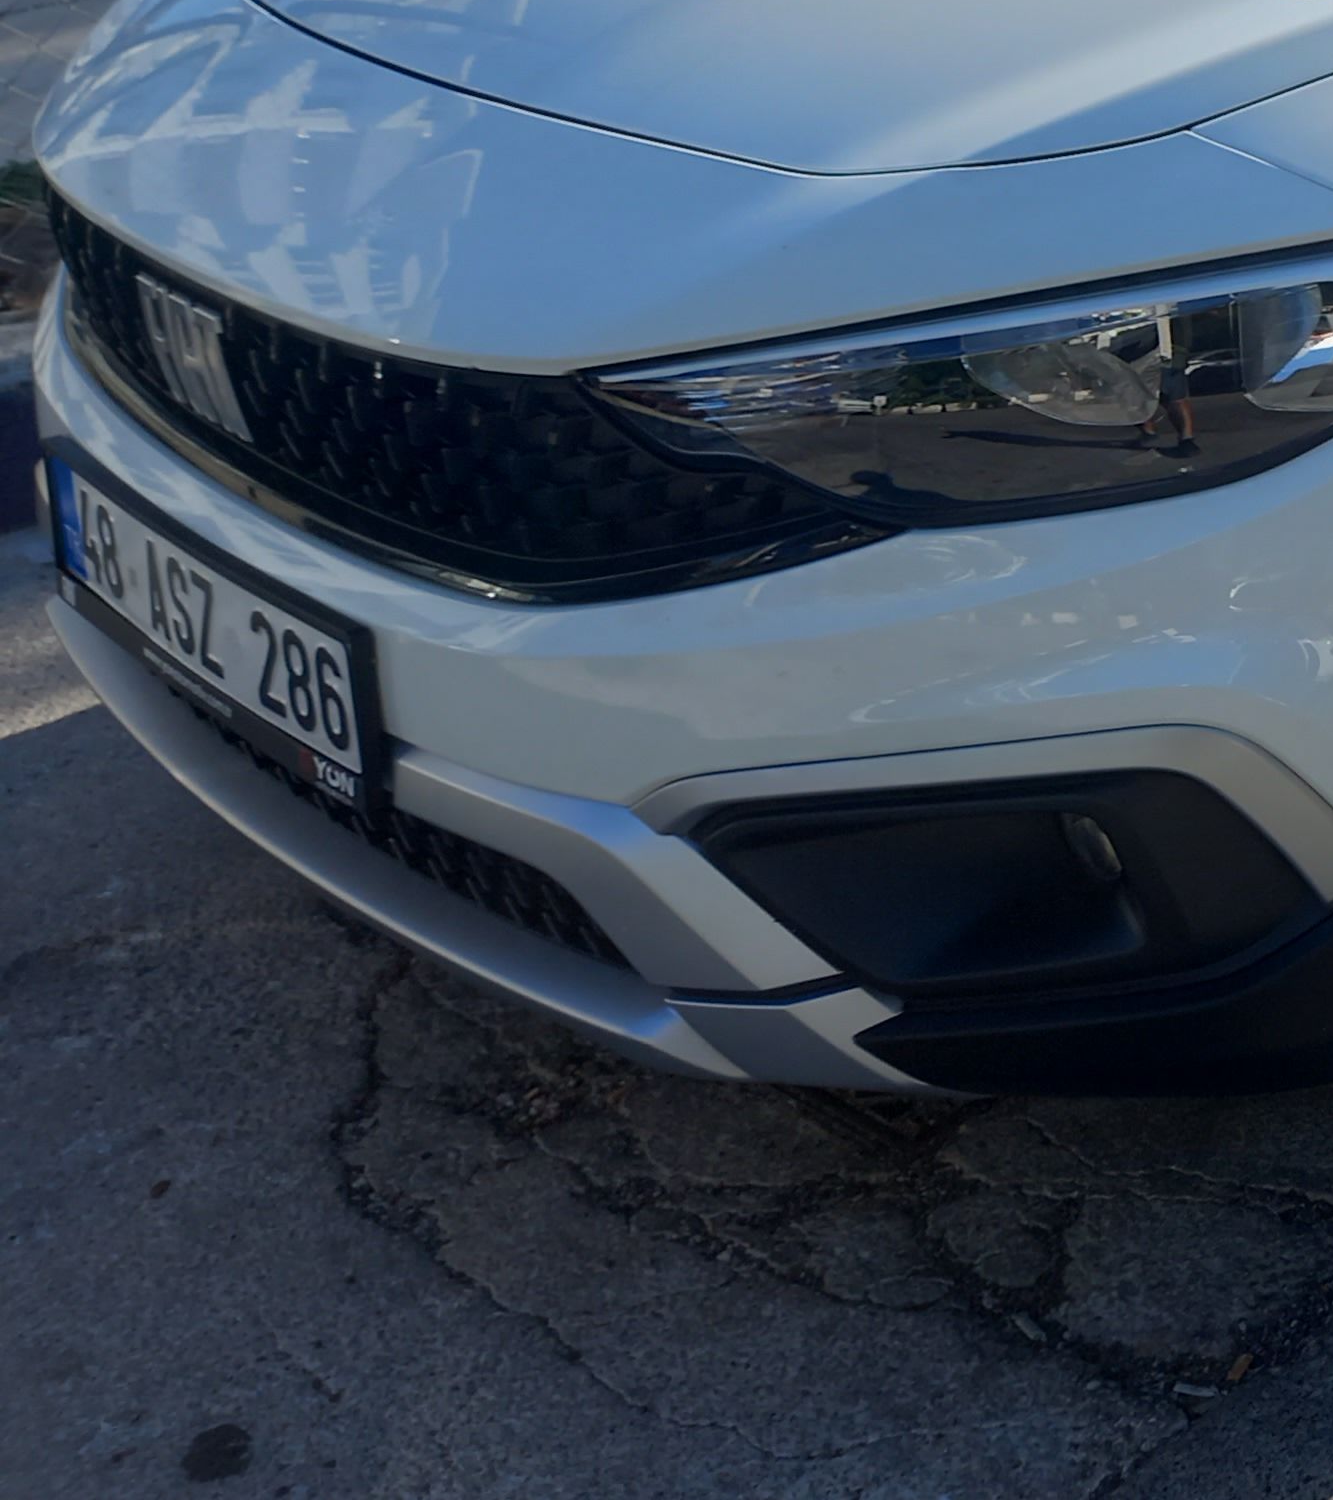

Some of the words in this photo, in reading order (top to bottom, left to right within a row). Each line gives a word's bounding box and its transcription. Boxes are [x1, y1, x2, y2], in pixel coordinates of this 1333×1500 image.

[80, 489, 125, 601] 48
[146, 539, 225, 680] ASZ
[250, 610, 350, 752] 286
